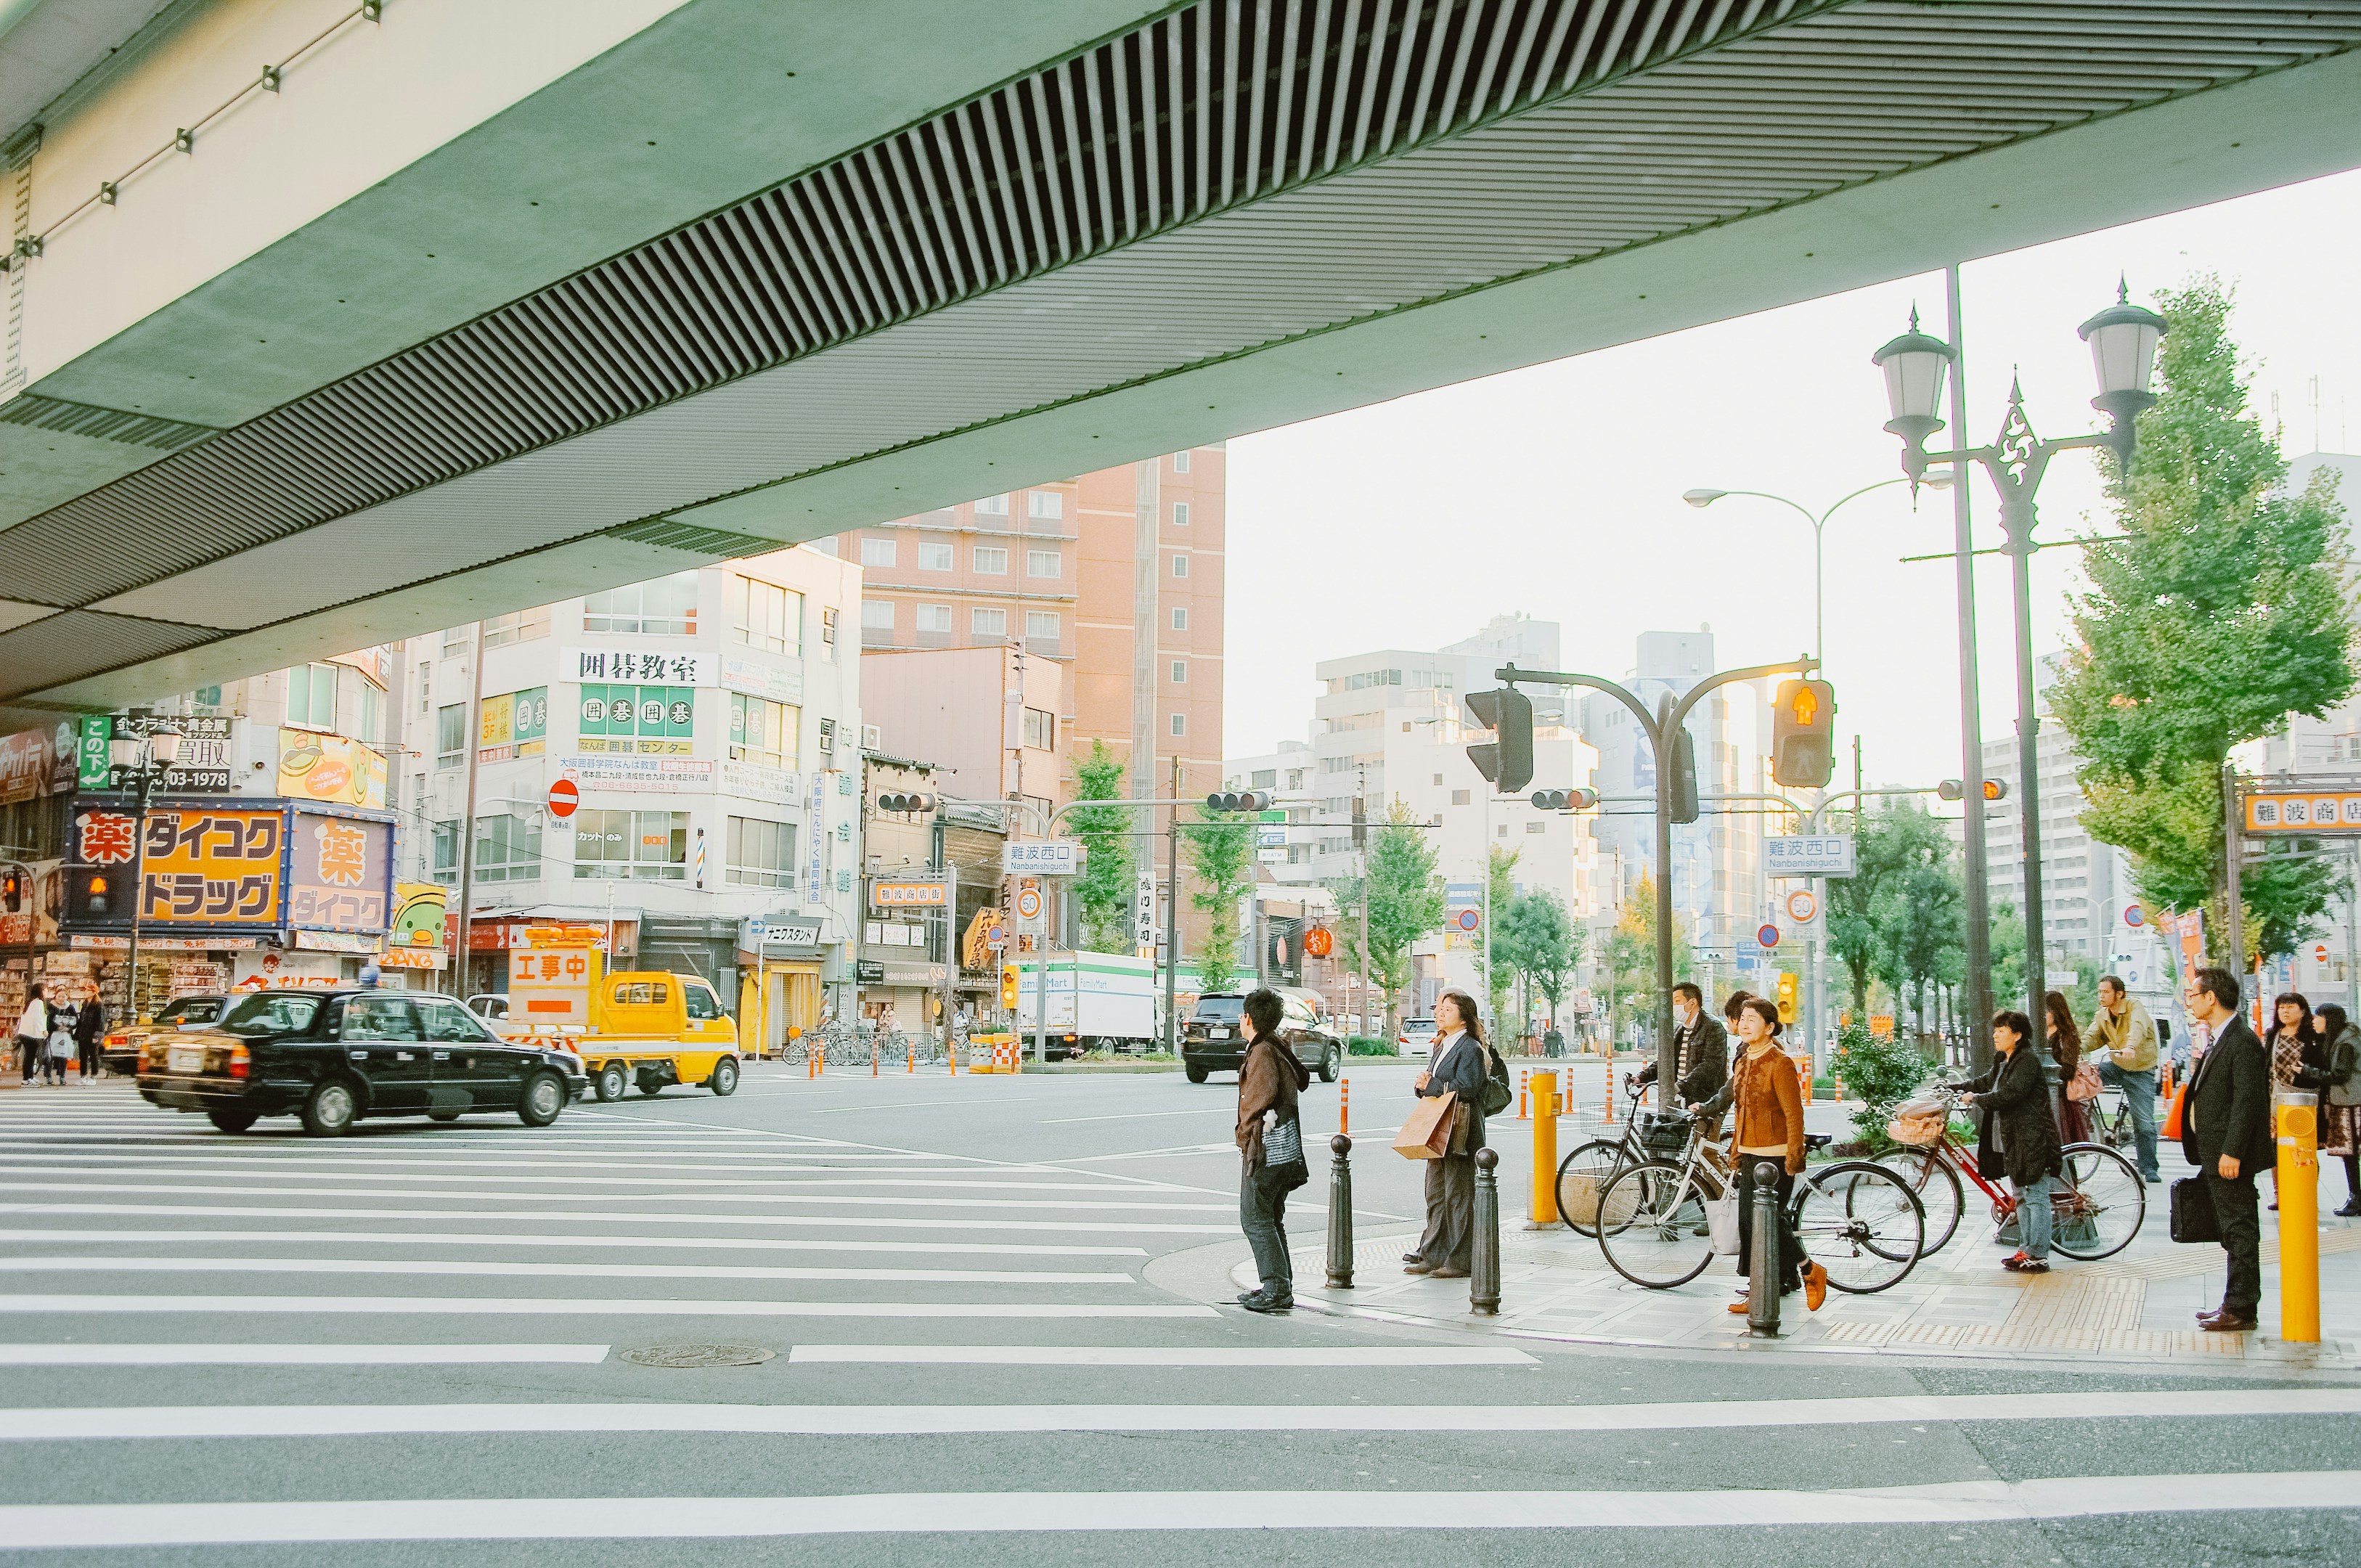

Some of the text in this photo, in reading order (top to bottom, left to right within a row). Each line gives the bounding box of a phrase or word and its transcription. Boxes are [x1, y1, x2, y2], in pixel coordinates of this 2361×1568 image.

[579, 651, 698, 683] 囲碁教室
[499, 701, 509, 740] 将棋
[520, 700, 547, 726] 囲碁
[585, 701, 693, 727] 囲碁 囲碁
[732, 709, 762, 735] 囲碁
[483, 724, 495, 740] 3F
[85, 720, 105, 771] この下
[83, 814, 136, 863] 薬
[146, 814, 279, 860] ダイコク
[577, 831, 623, 842] カットのみ
[1769, 840, 1841, 856] 難波西口
[318, 825, 367, 886] 薬
[1011, 846, 1069, 859] 難波西口
[1769, 859, 1842, 867] Nanbanishiguchi
[1011, 862, 1069, 871] Nanbanishiguchi
[144, 873, 273, 918] ドラッグ
[881, 889, 941, 900] 難波商店街
[1022, 897, 1036, 910] 50
[1794, 899, 1811, 912] 50
[295, 891, 382, 926] ダイコク
[767, 927, 812, 942] ナニワスタンド
[515, 955, 585, 982] 工事中
[1080, 978, 1107, 990] FamilyMart
